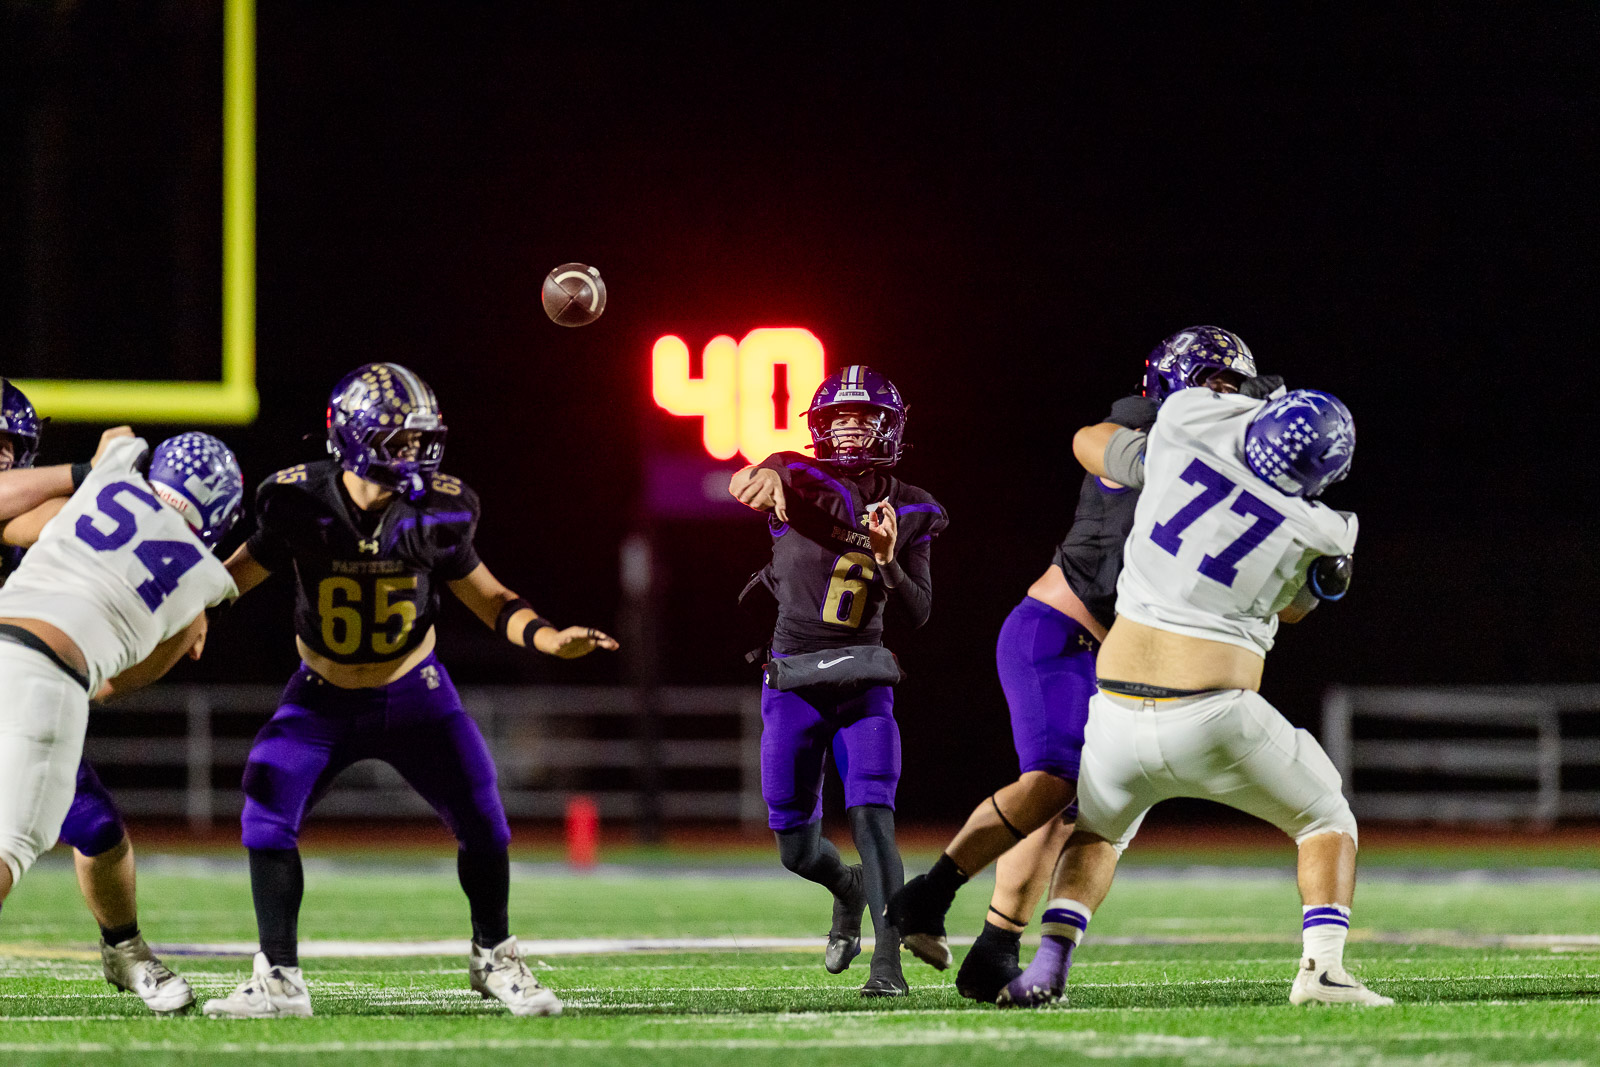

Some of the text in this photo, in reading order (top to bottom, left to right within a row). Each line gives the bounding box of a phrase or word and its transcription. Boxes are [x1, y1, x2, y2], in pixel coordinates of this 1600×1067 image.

[651, 327, 825, 465] 40
[75, 481, 204, 614] 54
[831, 525, 872, 550] PANT
[1149, 457, 1287, 588] 77
[318, 576, 418, 655] 65
[820, 551, 876, 629] 6
